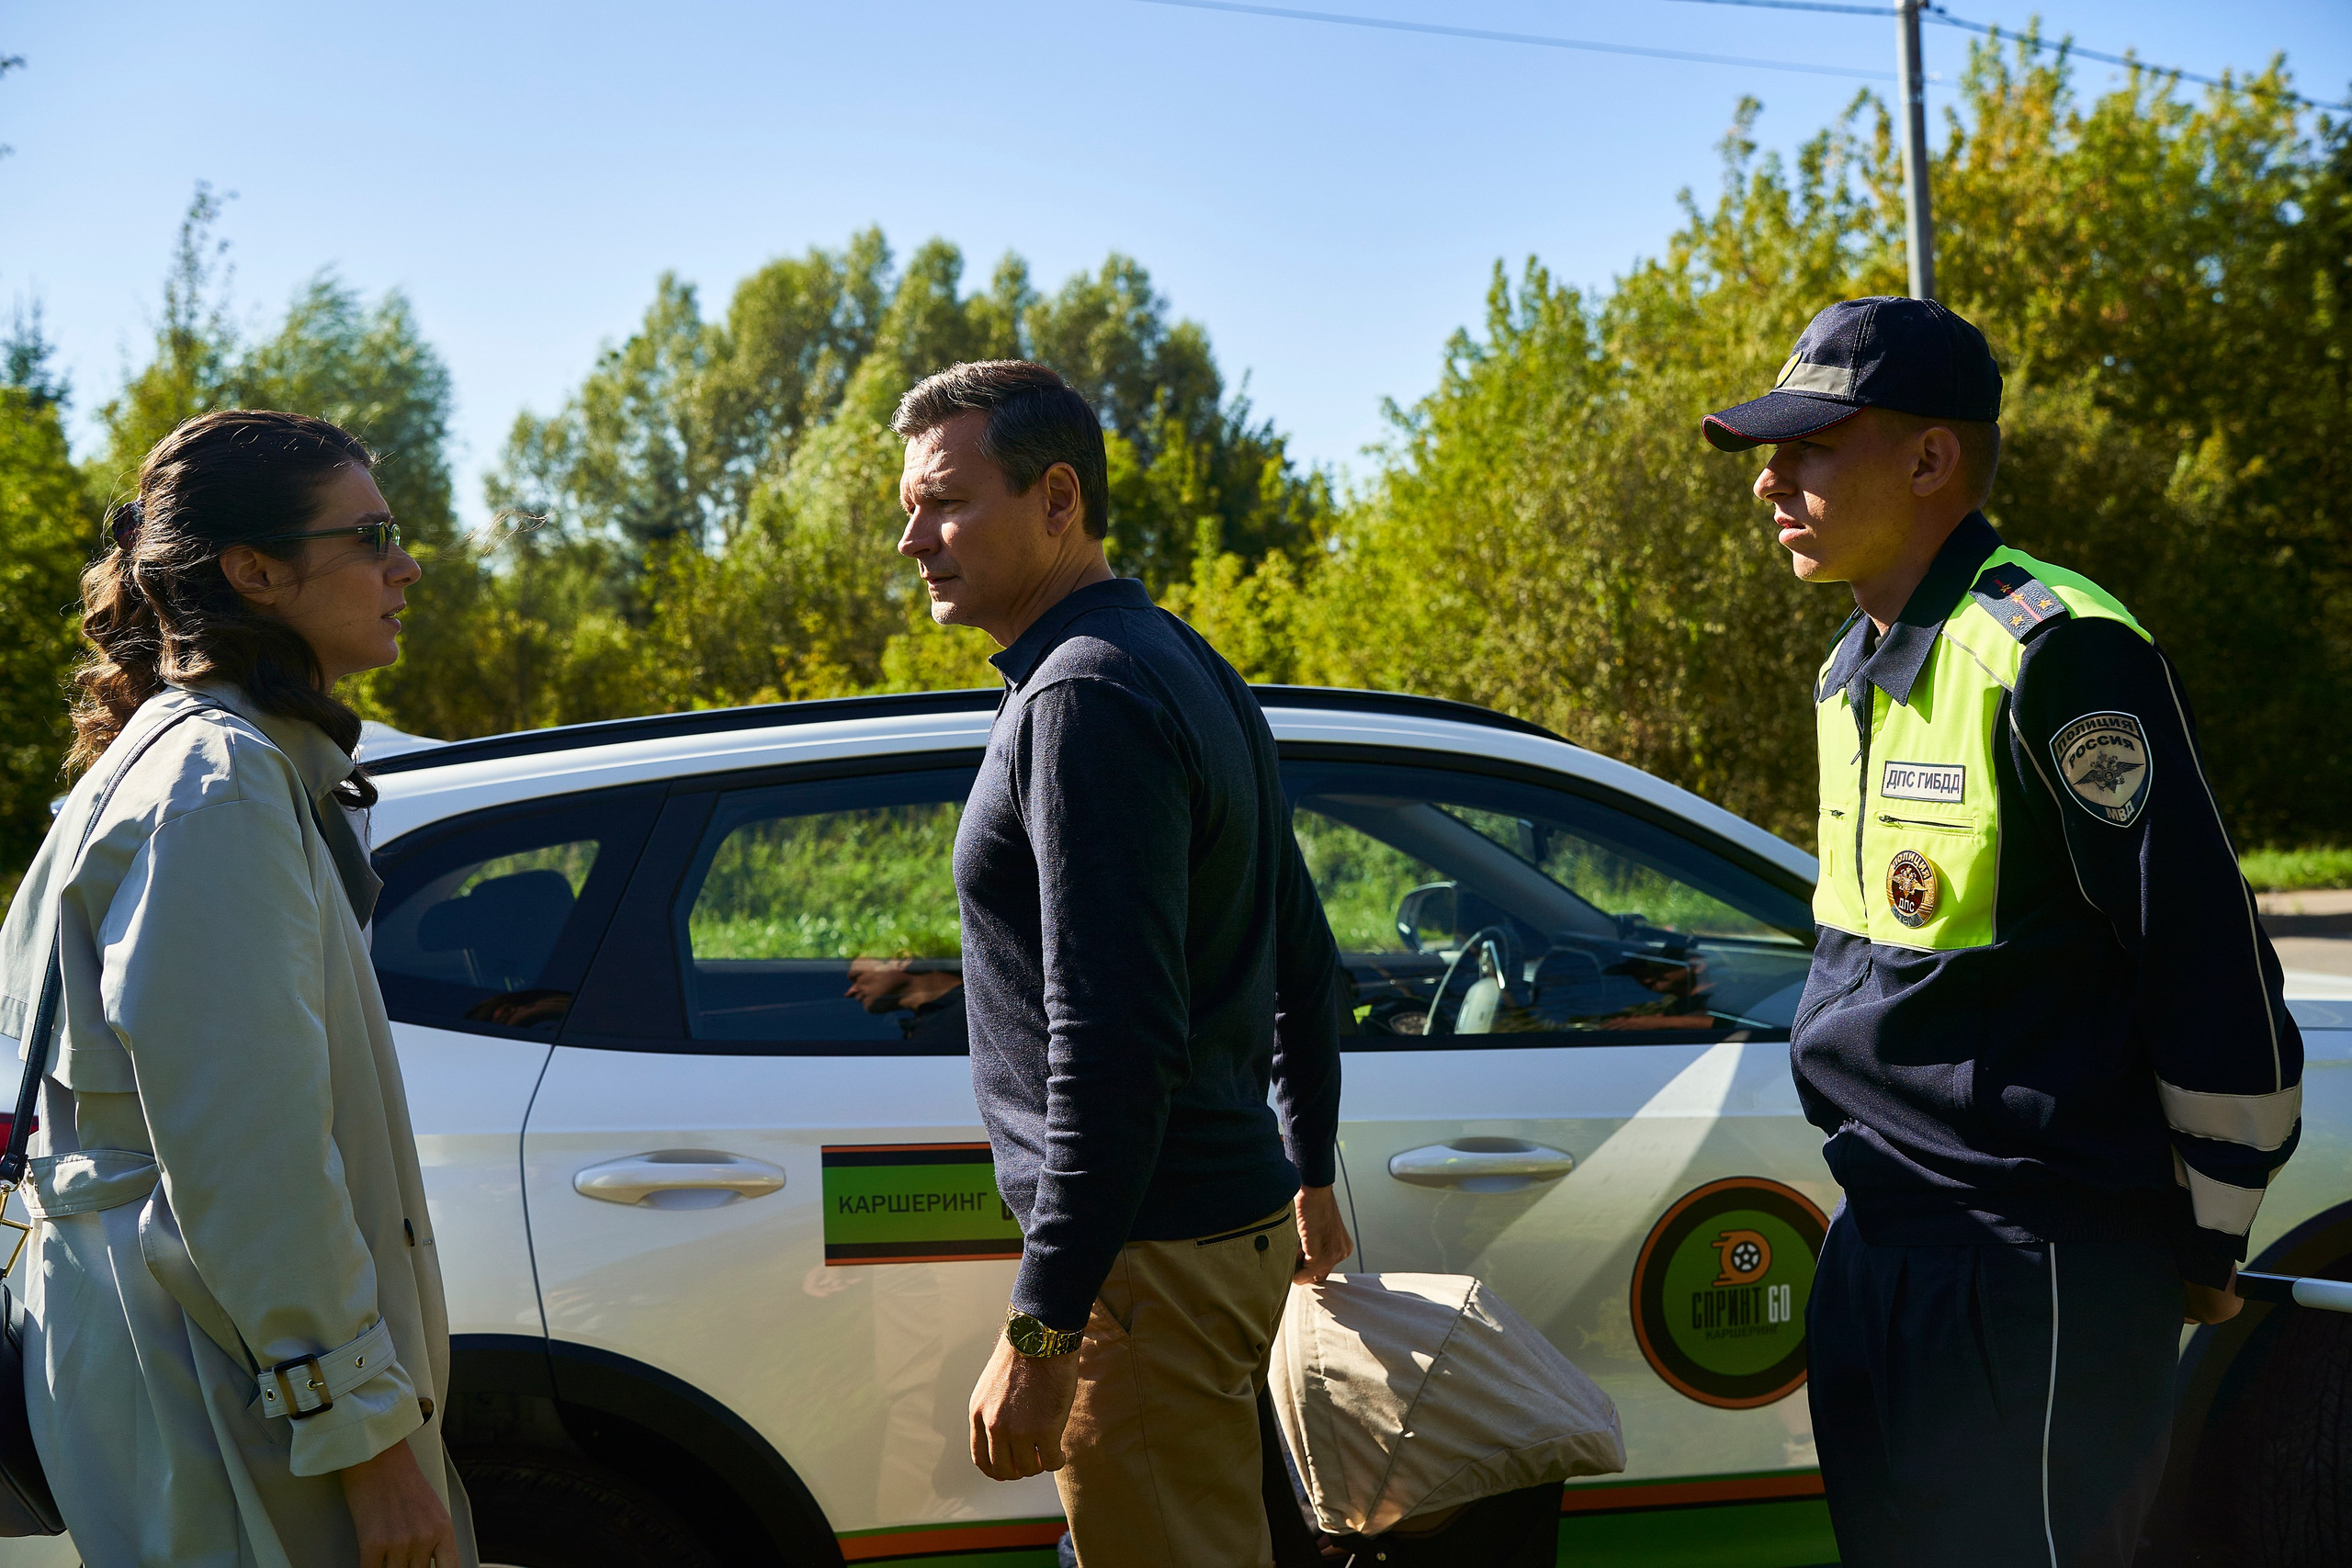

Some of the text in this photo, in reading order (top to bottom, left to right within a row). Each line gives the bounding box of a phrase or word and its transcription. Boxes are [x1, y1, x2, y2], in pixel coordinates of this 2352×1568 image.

[2058, 717, 2136, 753] ПОЛИЦИЯ
[2068, 735, 2136, 769] РОССИЯ
[1886, 770, 1960, 795] ДПС ГИБДД
[2105, 800, 2135, 822] МВД
[1893, 852, 1930, 879] ПОЛИЦИЯ
[1898, 897, 1915, 912] ДПС
[839, 1192, 988, 1214] КАРШЕРИНГ
[1692, 1283, 1791, 1329] СПРИНТ GO
[1705, 1324, 1780, 1341] КАРШЕРИНГ
